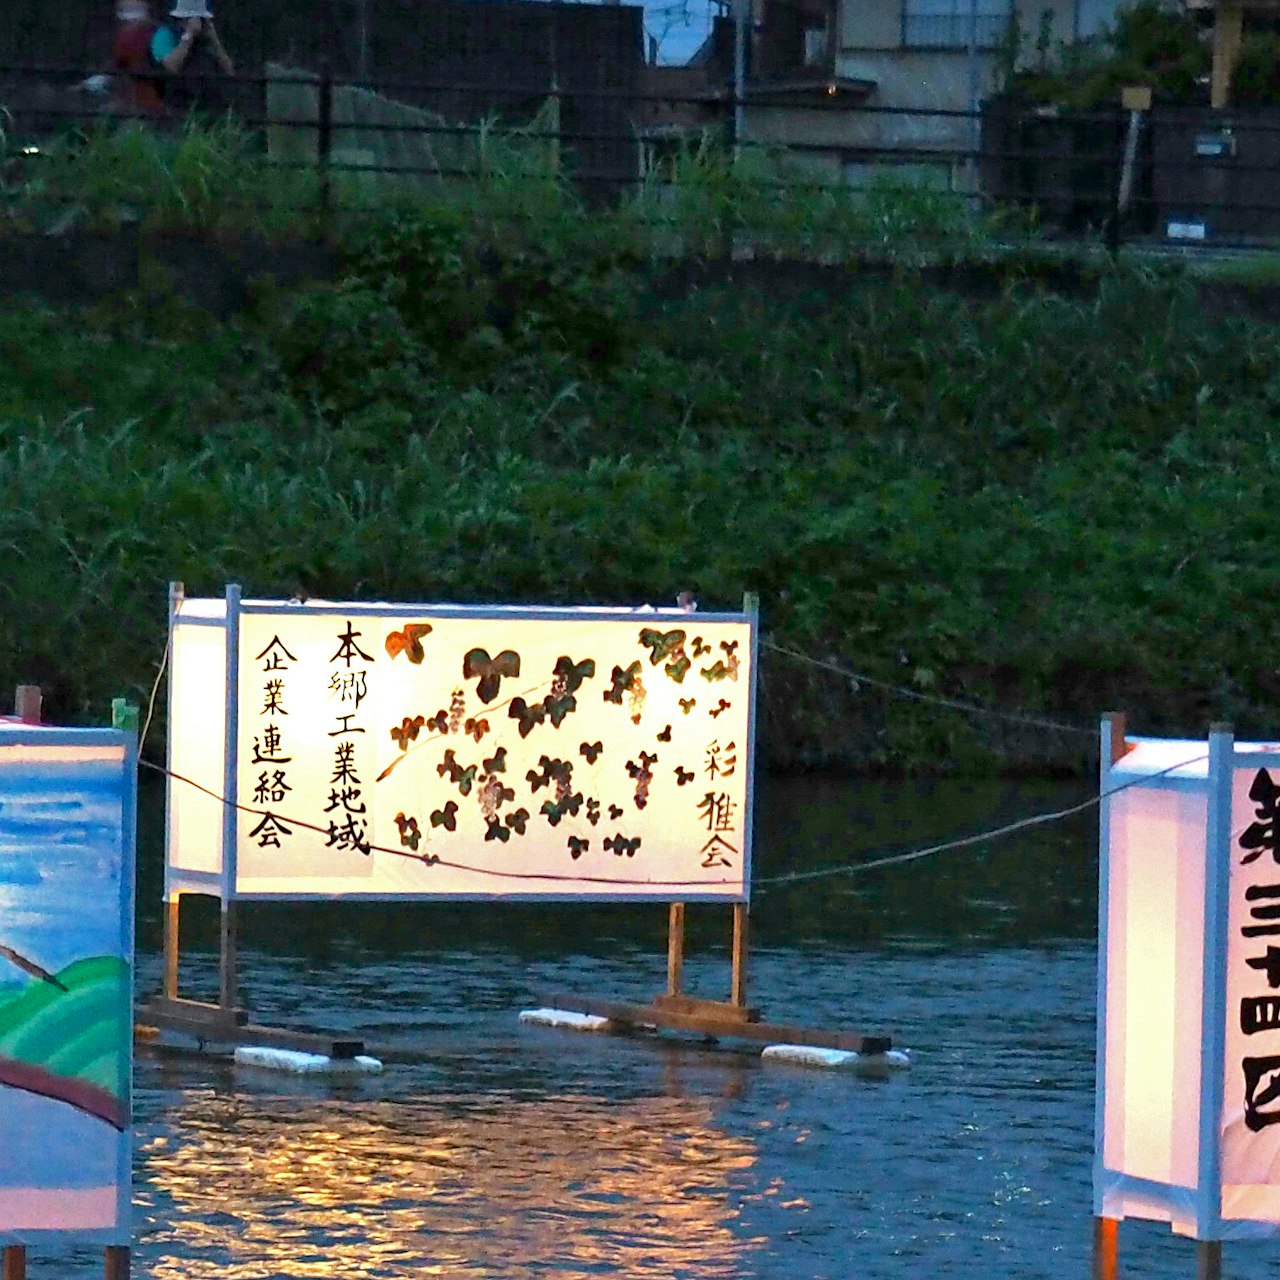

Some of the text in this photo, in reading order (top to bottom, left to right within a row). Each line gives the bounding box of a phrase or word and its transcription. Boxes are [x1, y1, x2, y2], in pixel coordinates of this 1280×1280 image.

[248, 634, 298, 850] 企業連絡会
[324, 620, 375, 857] 本郷工業地域
[695, 738, 739, 869] 彩雅会
